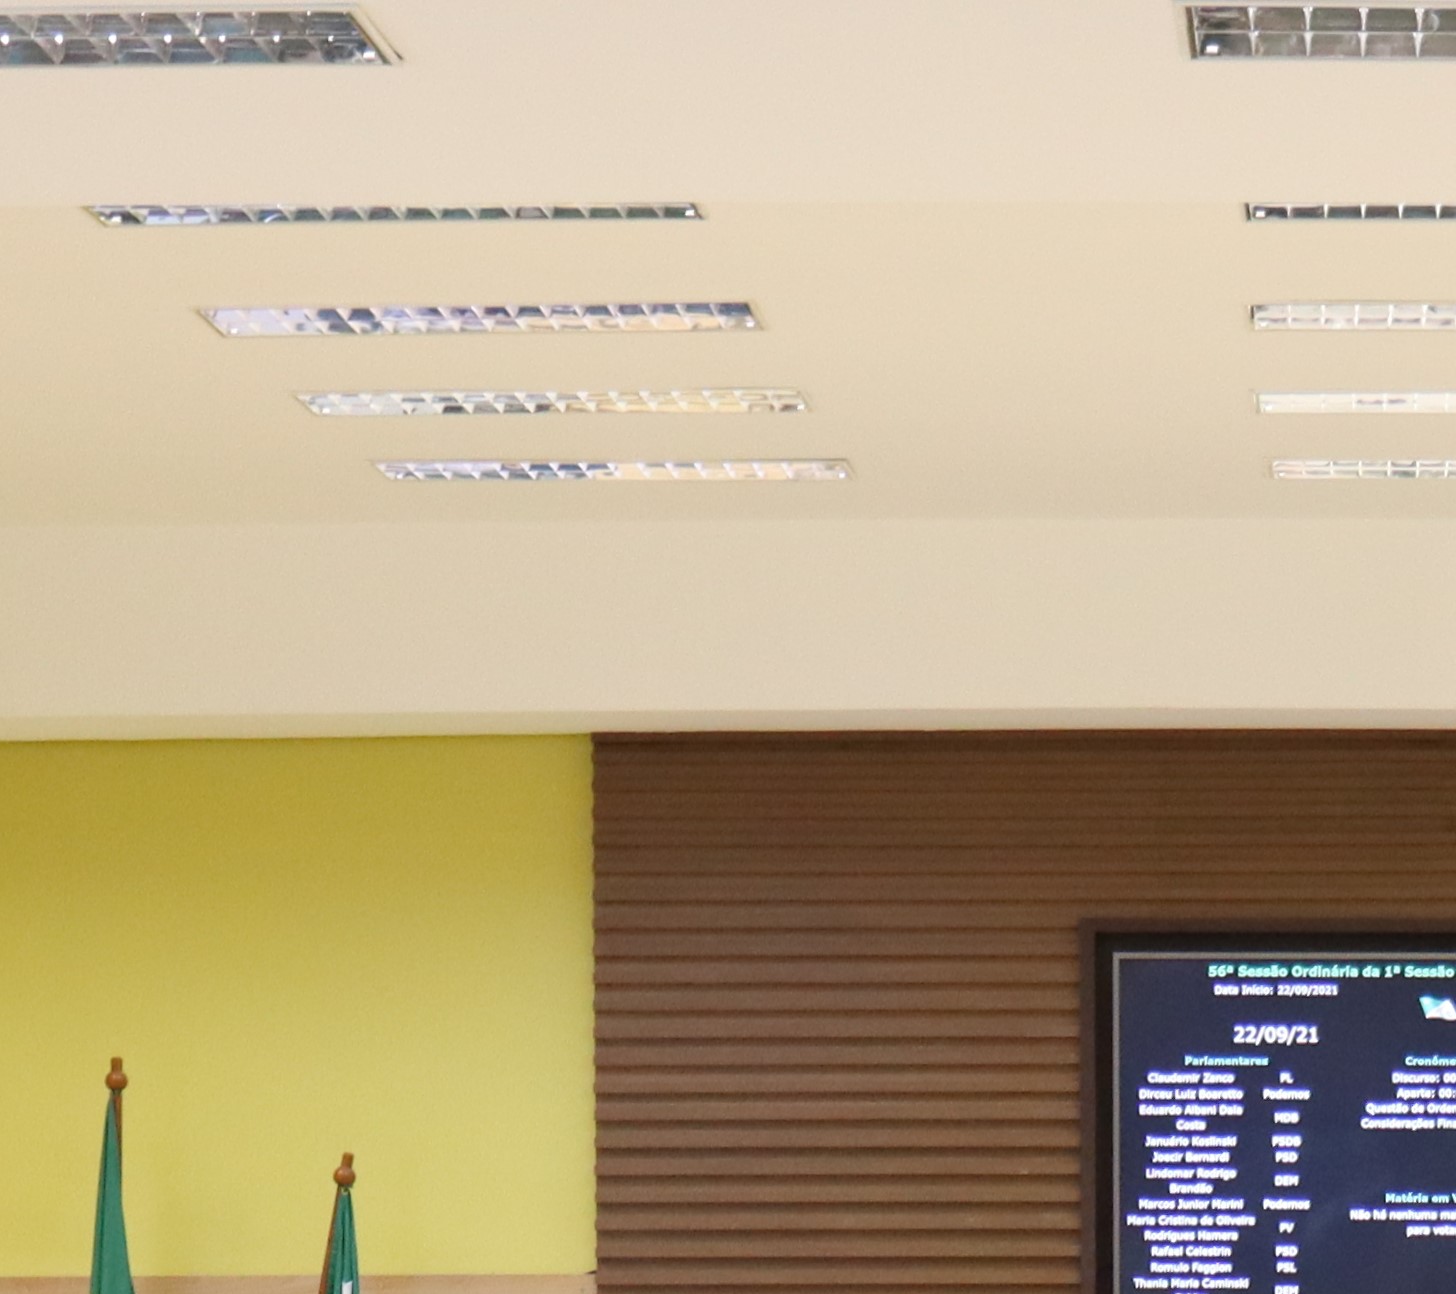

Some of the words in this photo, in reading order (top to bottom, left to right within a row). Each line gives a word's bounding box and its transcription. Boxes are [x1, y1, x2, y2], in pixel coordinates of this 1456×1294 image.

[1208, 965, 1233, 978] 56ª
[1238, 964, 1287, 978] Sessão
[1292, 964, 1358, 978] Ordinária
[1362, 966, 1379, 978] da
[1385, 966, 1401, 978] 1ª
[1404, 965, 1454, 979] Sessão
[1214, 984, 1239, 996] Data
[1241, 984, 1274, 996] Início:
[1277, 984, 1338, 997] 22/09/2021
[1233, 1025, 1319, 1046] 22/09/21
[1184, 1055, 1269, 1066] Parlamentares
[1147, 1072, 1201, 1084] Claudemir
[1392, 1072, 1440, 1084] Discurso:
[1139, 1088, 1172, 1100] Dirceu
[1263, 1088, 1311, 1100] Podemos
[1139, 1104, 1182, 1116] Eduardo
[1365, 1103, 1409, 1116] Questão
[1411, 1103, 1425, 1115] de
[1176, 1119, 1207, 1131] Costa
[1360, 1118, 1435, 1131] Considerações
[1145, 1135, 1189, 1147] Januário
[1185, 1151, 1230, 1163] Bernardi
[1146, 1168, 1195, 1179] Lindomar
[1196, 1168, 1237, 1181] Rodrigo
[1169, 1182, 1214, 1194] Brandão
[1138, 1198, 1176, 1210] Marcos
[1263, 1198, 1311, 1210] Podemos
[1385, 1192, 1429, 1204] Matéria
[1431, 1194, 1450, 1204] em
[1127, 1214, 1156, 1226] Maria
[1158, 1214, 1198, 1226] Cristina
[1200, 1214, 1214, 1226] de
[1215, 1214, 1256, 1226] Oliveira
[1349, 1209, 1371, 1220] Não
[1372, 1209, 1387, 1220] há
[1389, 1209, 1437, 1221] nenhuma
[1144, 1230, 1195, 1243] Rodrigues
[1406, 1226, 1431, 1237] para
[1151, 1245, 1184, 1257] Rafael
[1150, 1262, 1190, 1273] Romulo
[1171, 1278, 1199, 1289] Maria
